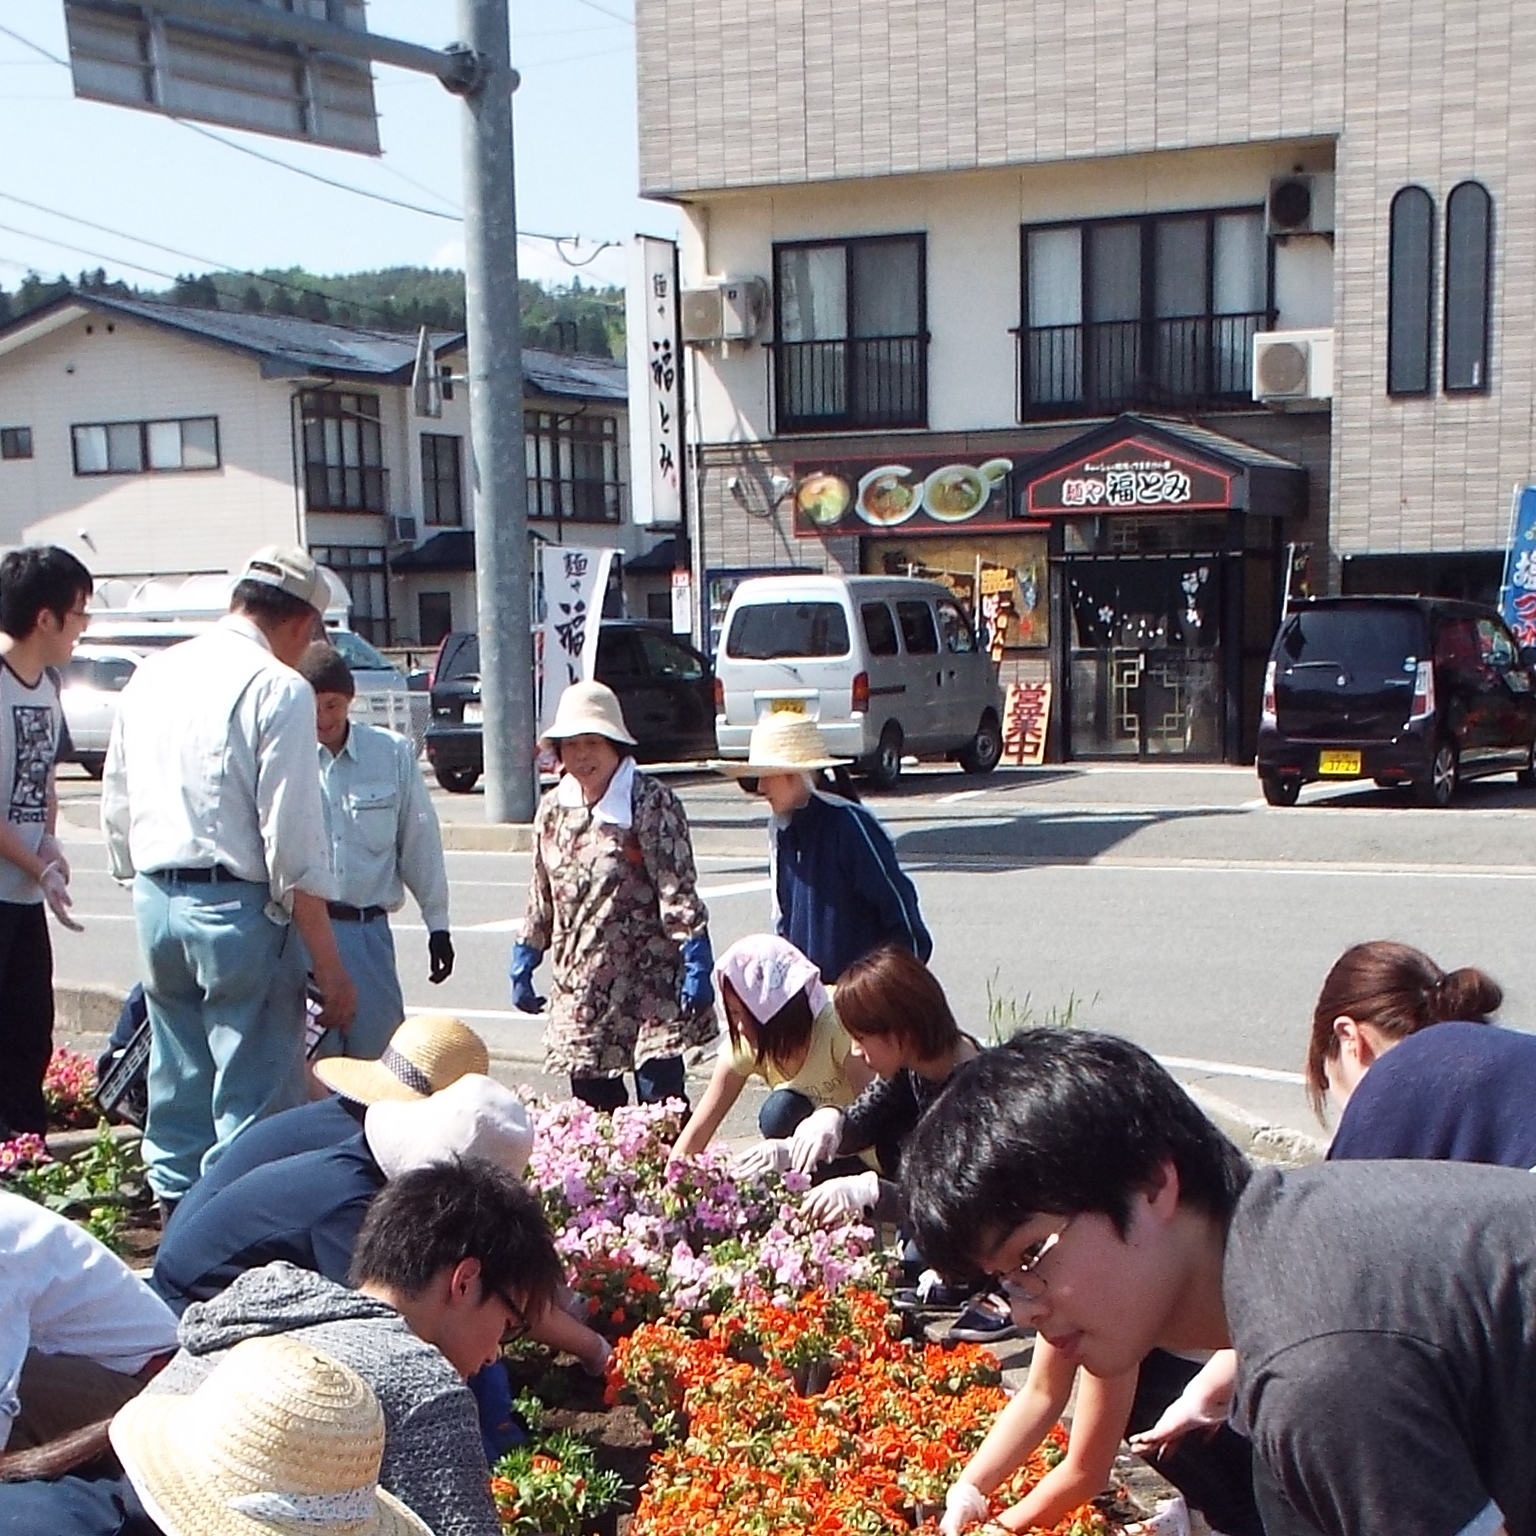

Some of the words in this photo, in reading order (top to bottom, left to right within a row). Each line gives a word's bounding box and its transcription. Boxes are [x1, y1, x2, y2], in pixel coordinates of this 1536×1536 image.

[1063, 471, 1191, 505] 麺や福とみ
[1003, 683, 1047, 765] 営業中
